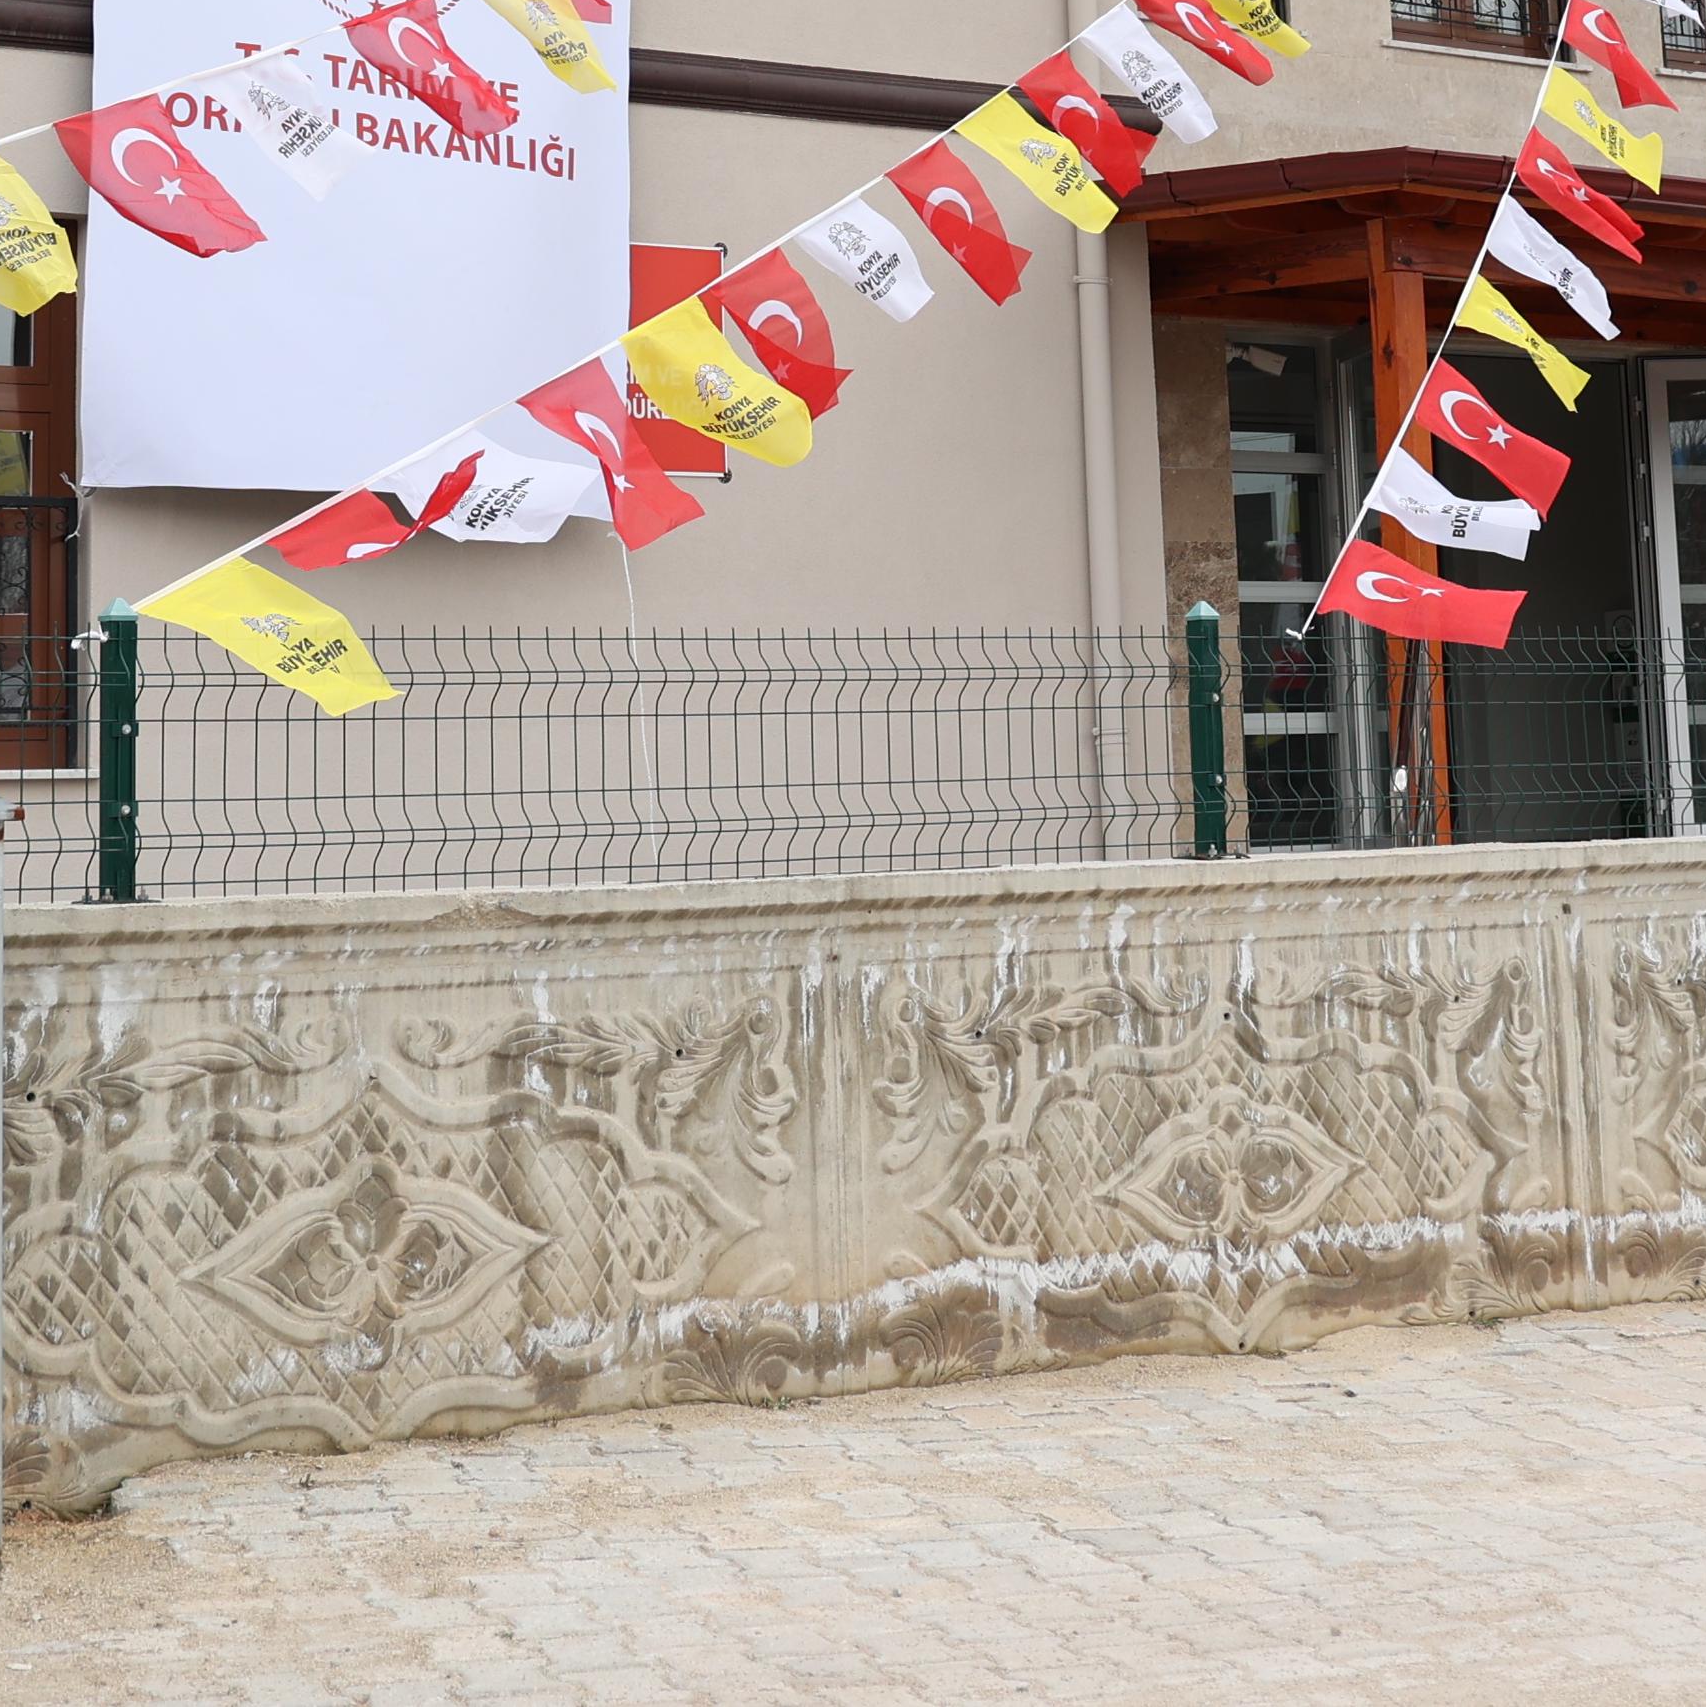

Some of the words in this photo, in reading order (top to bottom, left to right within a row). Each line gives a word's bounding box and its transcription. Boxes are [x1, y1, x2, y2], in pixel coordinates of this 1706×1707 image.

[1142, 79, 1168, 100] KONYA
[356, 113, 576, 182] BAKANLIĞI
[857, 250, 883, 276] KONYA
[714, 396, 753, 422] KONYA
[465, 487, 503, 528] KONYA
